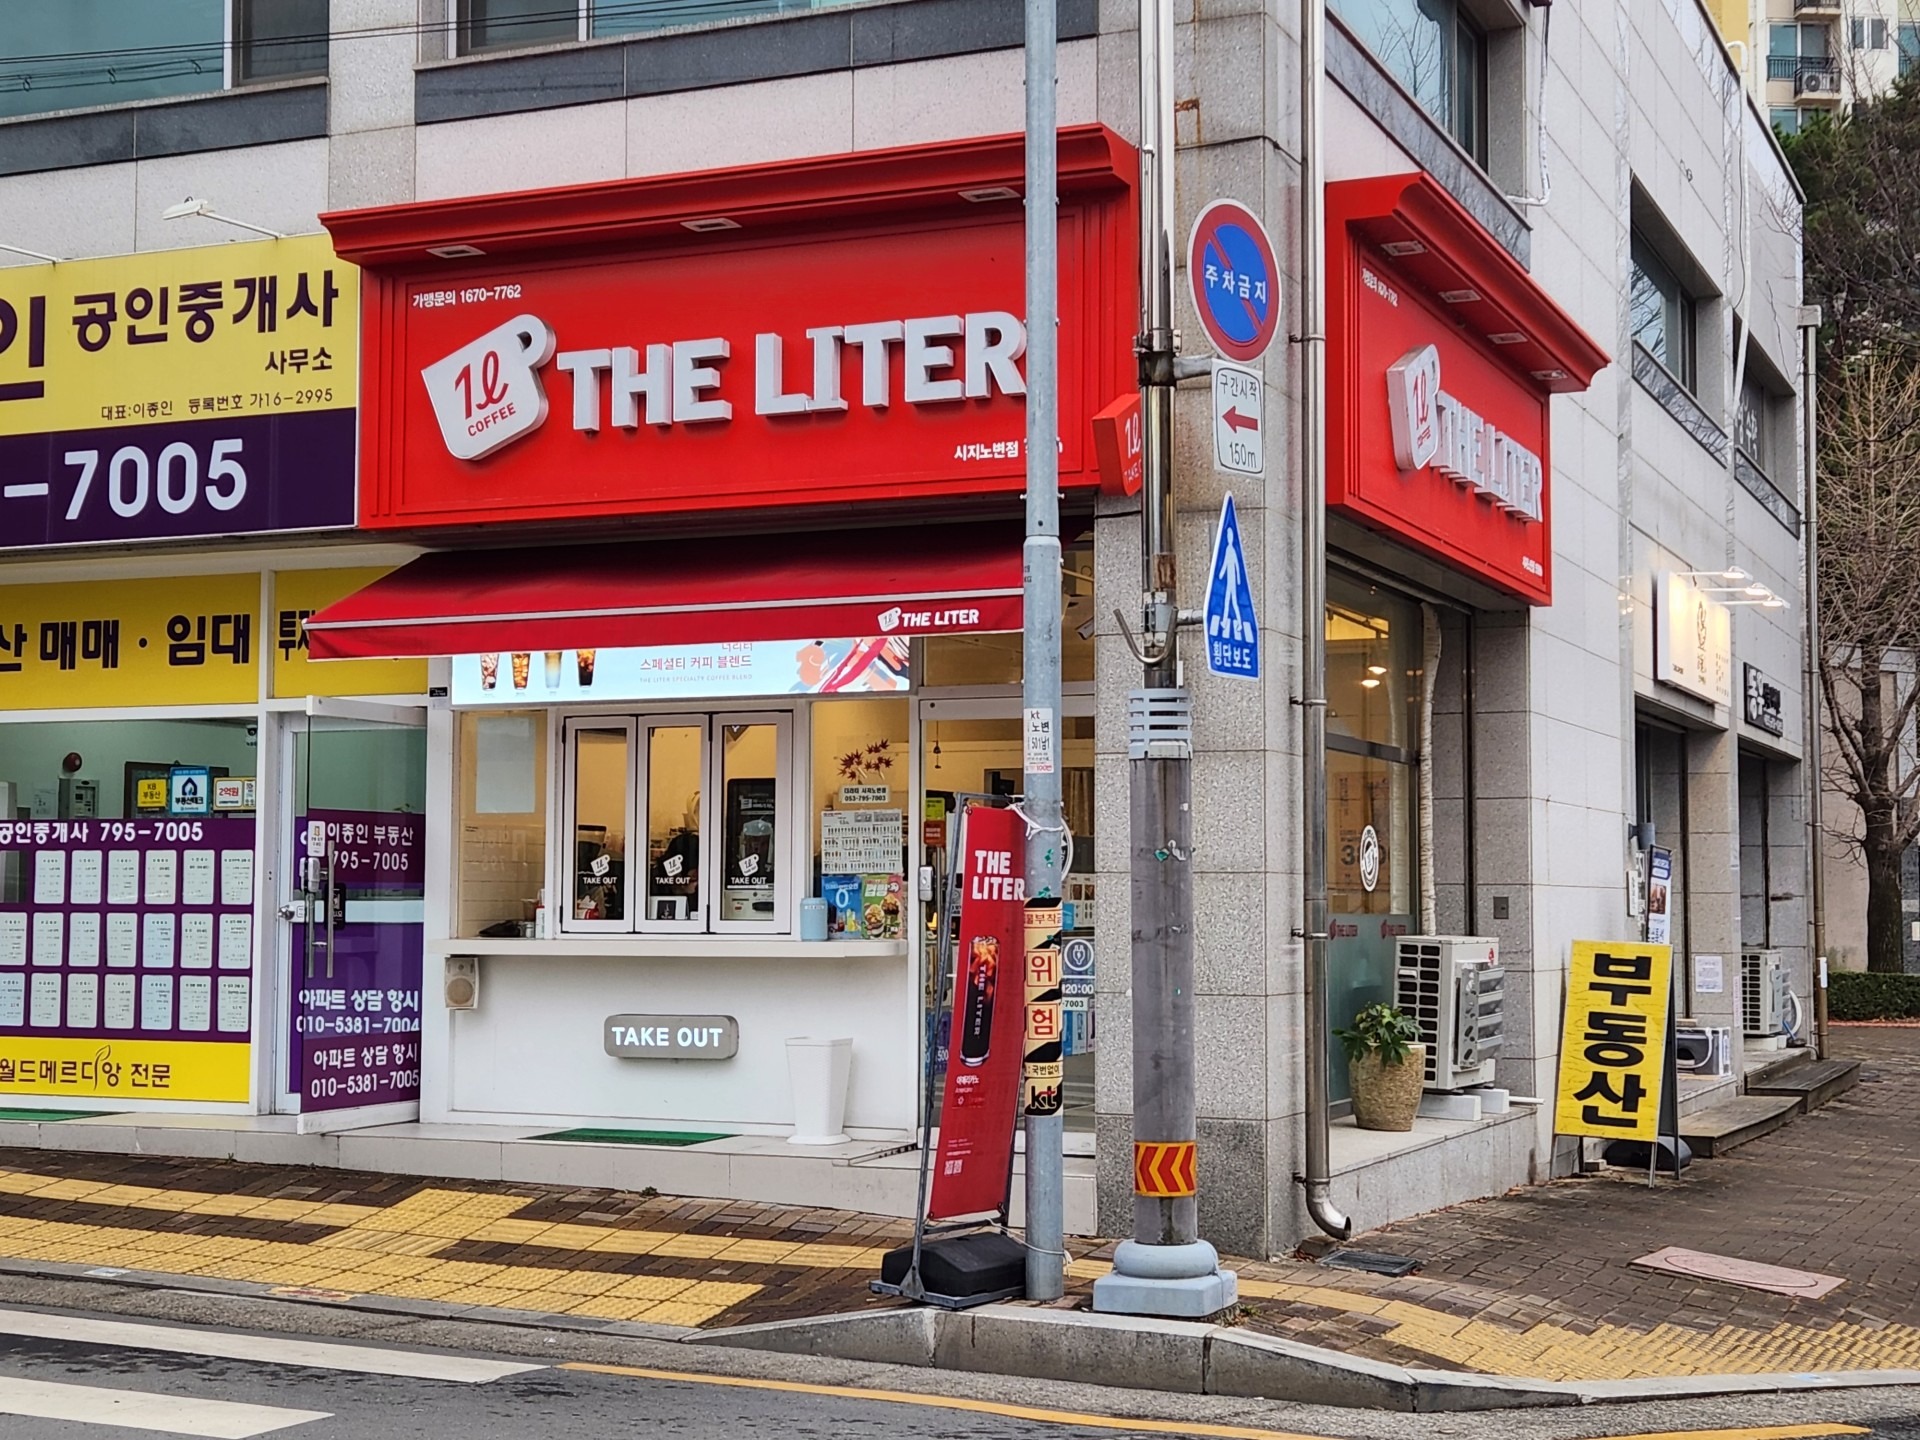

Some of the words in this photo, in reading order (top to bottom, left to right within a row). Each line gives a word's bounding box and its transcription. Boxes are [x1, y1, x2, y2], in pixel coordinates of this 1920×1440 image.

[413, 290, 456, 308] 가맹문의
[460, 284, 522, 303] 1670-7762
[1205, 264, 1267, 304] 주차금지
[72, 270, 339, 352] 공인중개사
[265, 347, 333, 375] 사무소
[557, 337, 732, 433] THE
[755, 311, 1027, 416] LITER
[1220, 373, 1258, 403] 구간시작
[101, 400, 173, 421] 대표:이종인
[188, 394, 243, 414] 등록번호
[250, 388, 333, 409] 가16-2995
[467, 402, 516, 437] COFFEE
[954, 440, 1019, 462] 시지노변점
[1429, 390, 1484, 488] THE
[1229, 440, 1257, 470] 150m
[902, 612, 931, 628] THE
[934, 609, 979, 625] LITER
[40, 619, 120, 670] 매매
[167, 614, 250, 666] 임대
[1212, 641, 1252, 669] 횡단보도
[640, 657, 685, 671] 스페셜티
[691, 656, 713, 669] 커피
[717, 655, 752, 669] 블렌드
[1031, 710, 1040, 720] kt
[1032, 721, 1050, 733] 노변
[0, 822, 89, 845] 공인중개사
[100, 822, 204, 842] 795-7005
[327, 822, 369, 845] 이종인
[374, 825, 414, 846] 부동산
[975, 850, 1012, 875] THE
[583, 877, 601, 885] TAKE
[602, 877, 618, 885] OUT
[655, 877, 674, 885] TAKE
[675, 877, 691, 885] OUT
[731, 877, 749, 885] TAKE
[750, 877, 767, 885] OUT
[972, 877, 1025, 900] LITER
[299, 989, 346, 1011] 아파트
[350, 989, 384, 1012] 상담
[387, 989, 419, 1013] 항시
[611, 1026, 670, 1046] TAKE
[677, 1026, 723, 1048] OUT
[1573, 953, 1653, 1129] 부동산
[313, 1047, 356, 1071] 아파트
[361, 1045, 389, 1068] 상담
[392, 1042, 417, 1066] 항시
[131, 1063, 170, 1089] 전문
[311, 1068, 420, 1099] 010-5381-7005
[1030, 1085, 1057, 1111] kt
